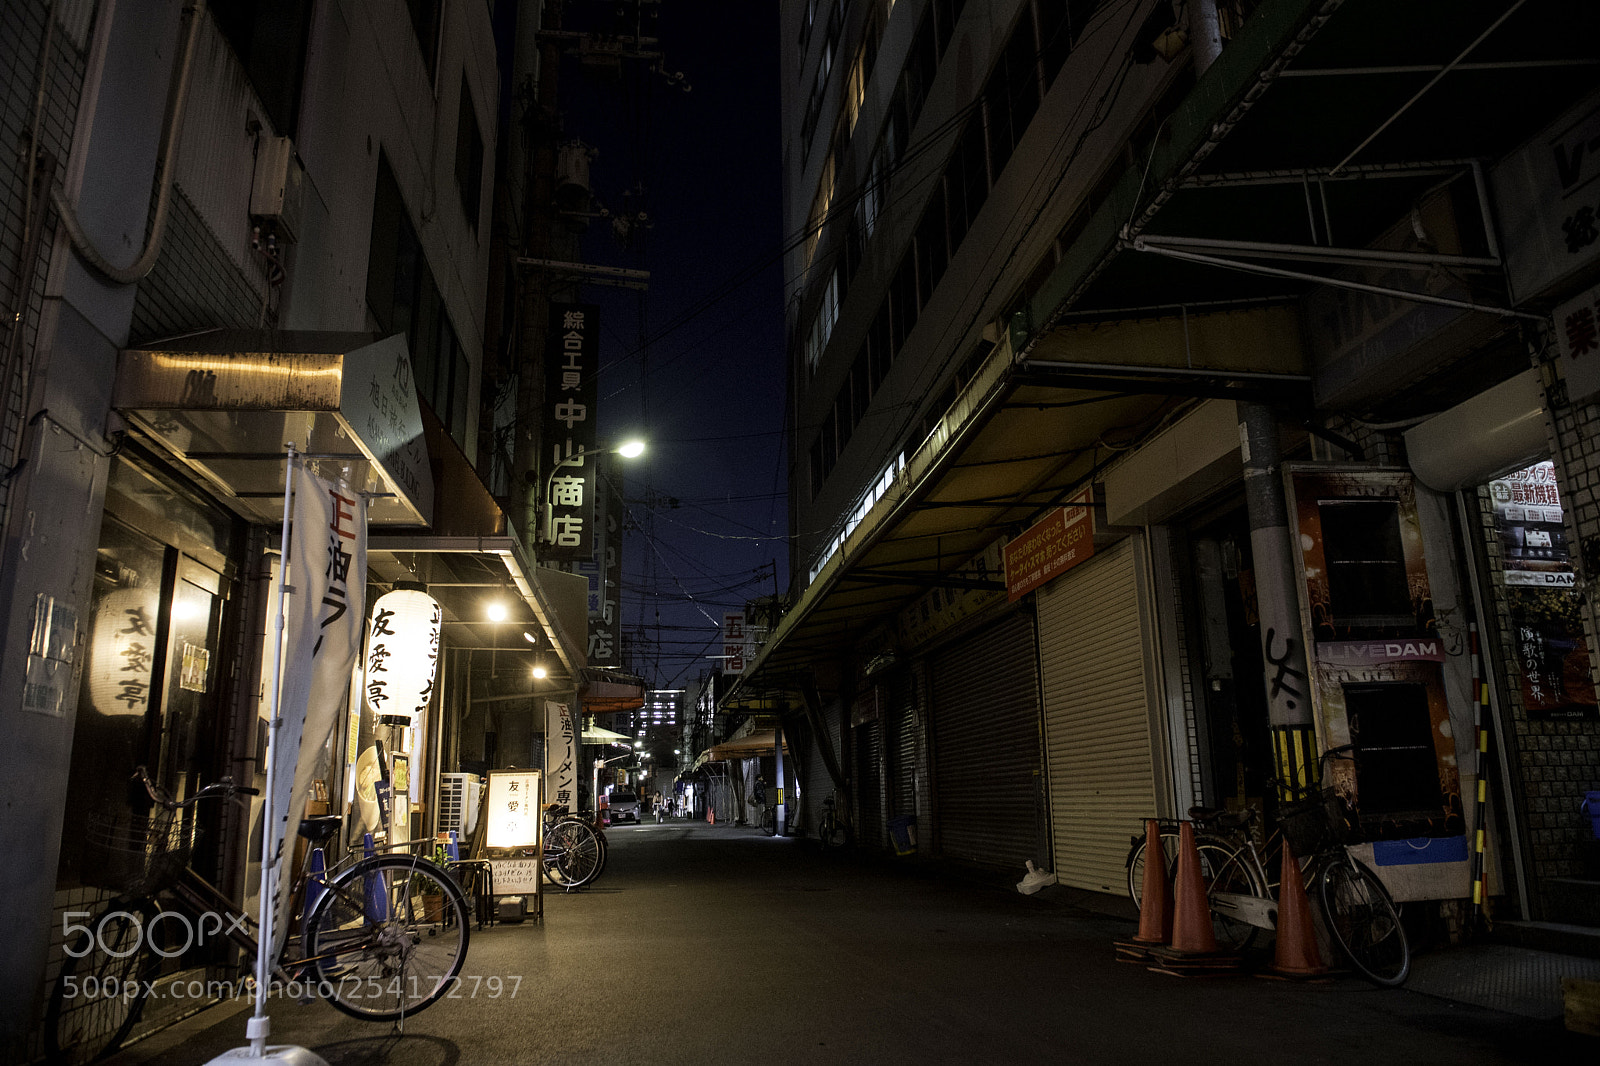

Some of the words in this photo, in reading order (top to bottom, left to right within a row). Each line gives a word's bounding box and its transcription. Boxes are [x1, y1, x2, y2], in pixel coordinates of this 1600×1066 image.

[551, 397, 587, 547] 中山商店
[1511, 483, 1559, 504] 最新機種
[368, 608, 395, 709] 友愛亭
